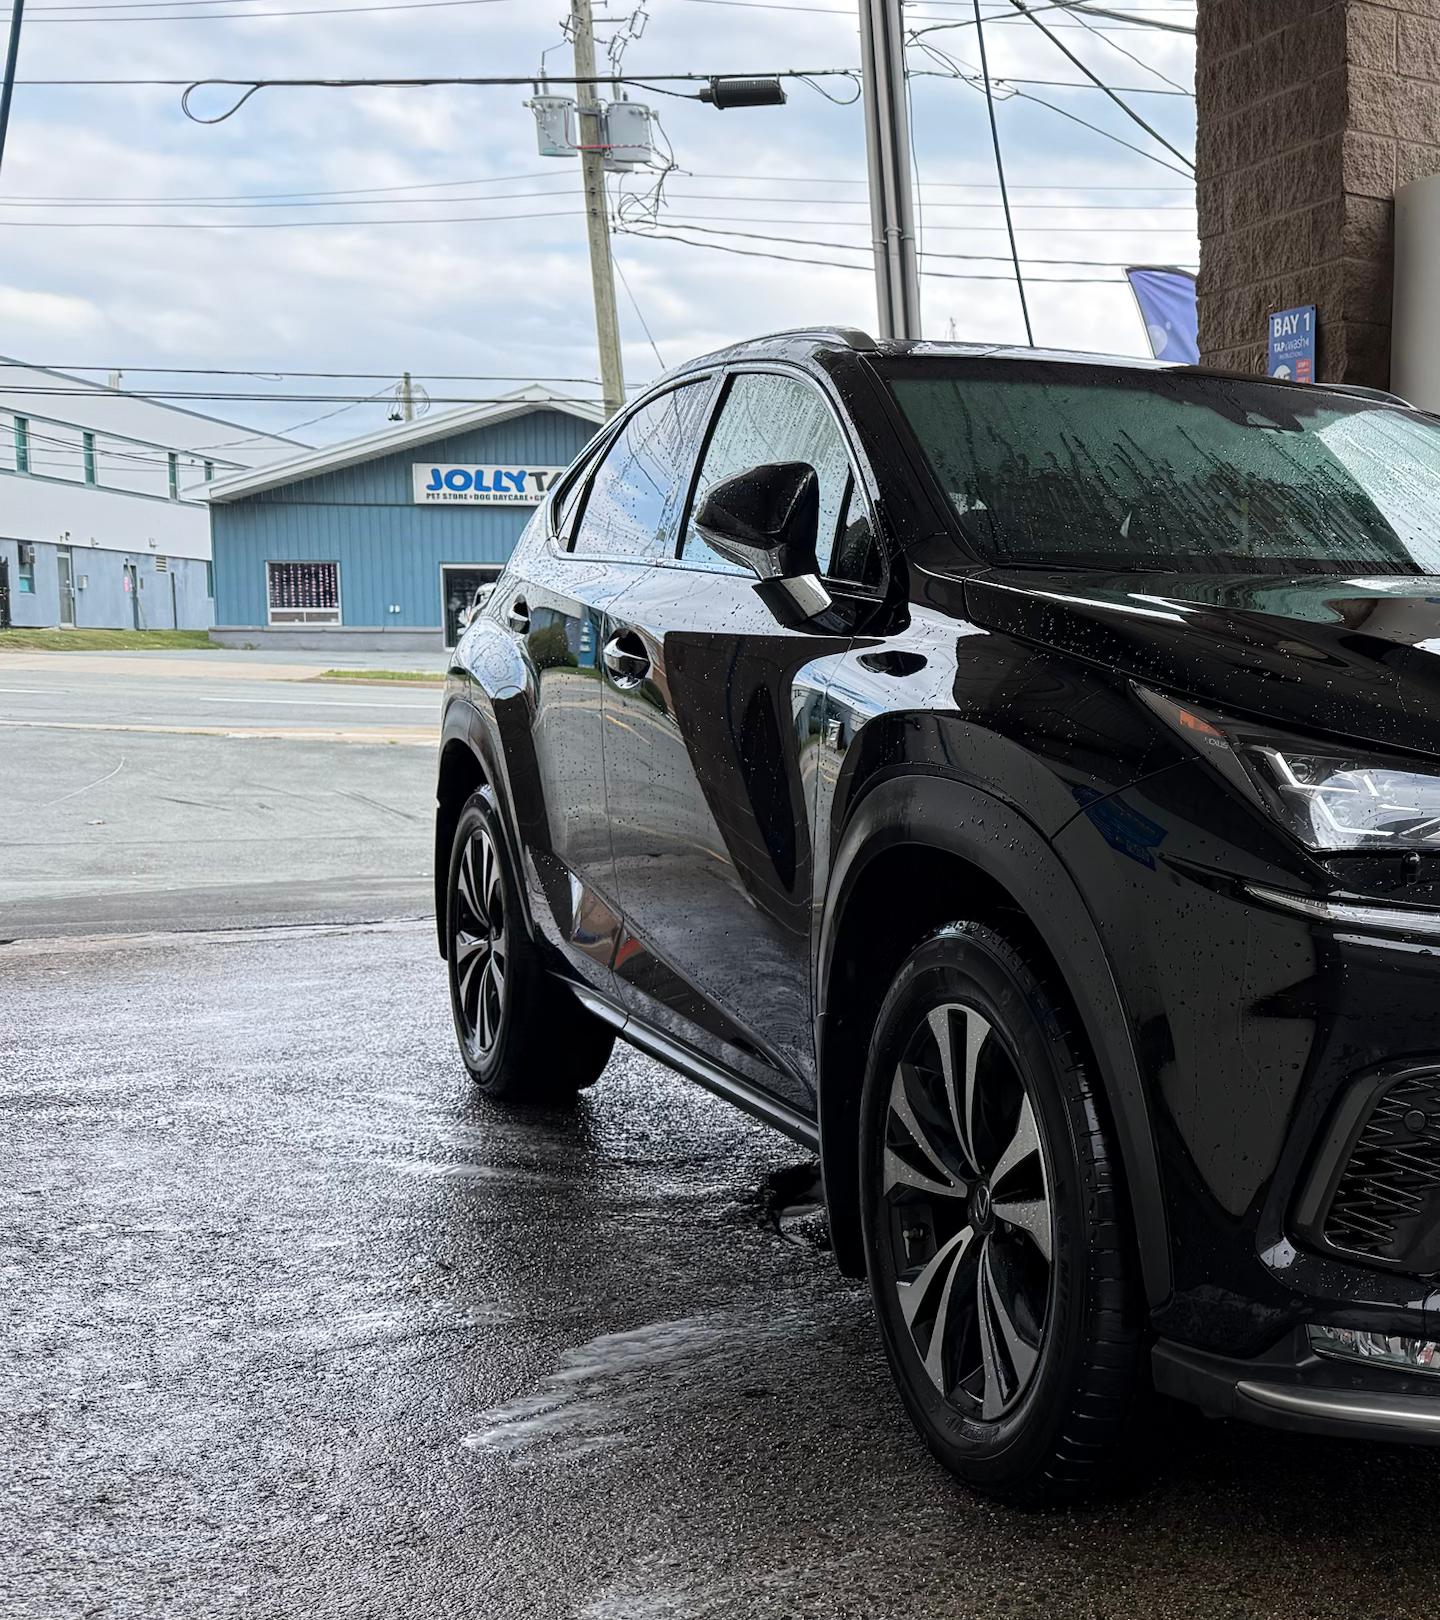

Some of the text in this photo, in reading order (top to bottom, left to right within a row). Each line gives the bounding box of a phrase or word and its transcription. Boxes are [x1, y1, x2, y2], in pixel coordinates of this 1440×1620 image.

[1274, 312, 1310, 338] BAY 1
[493, 494, 528, 502] DAYCARE
